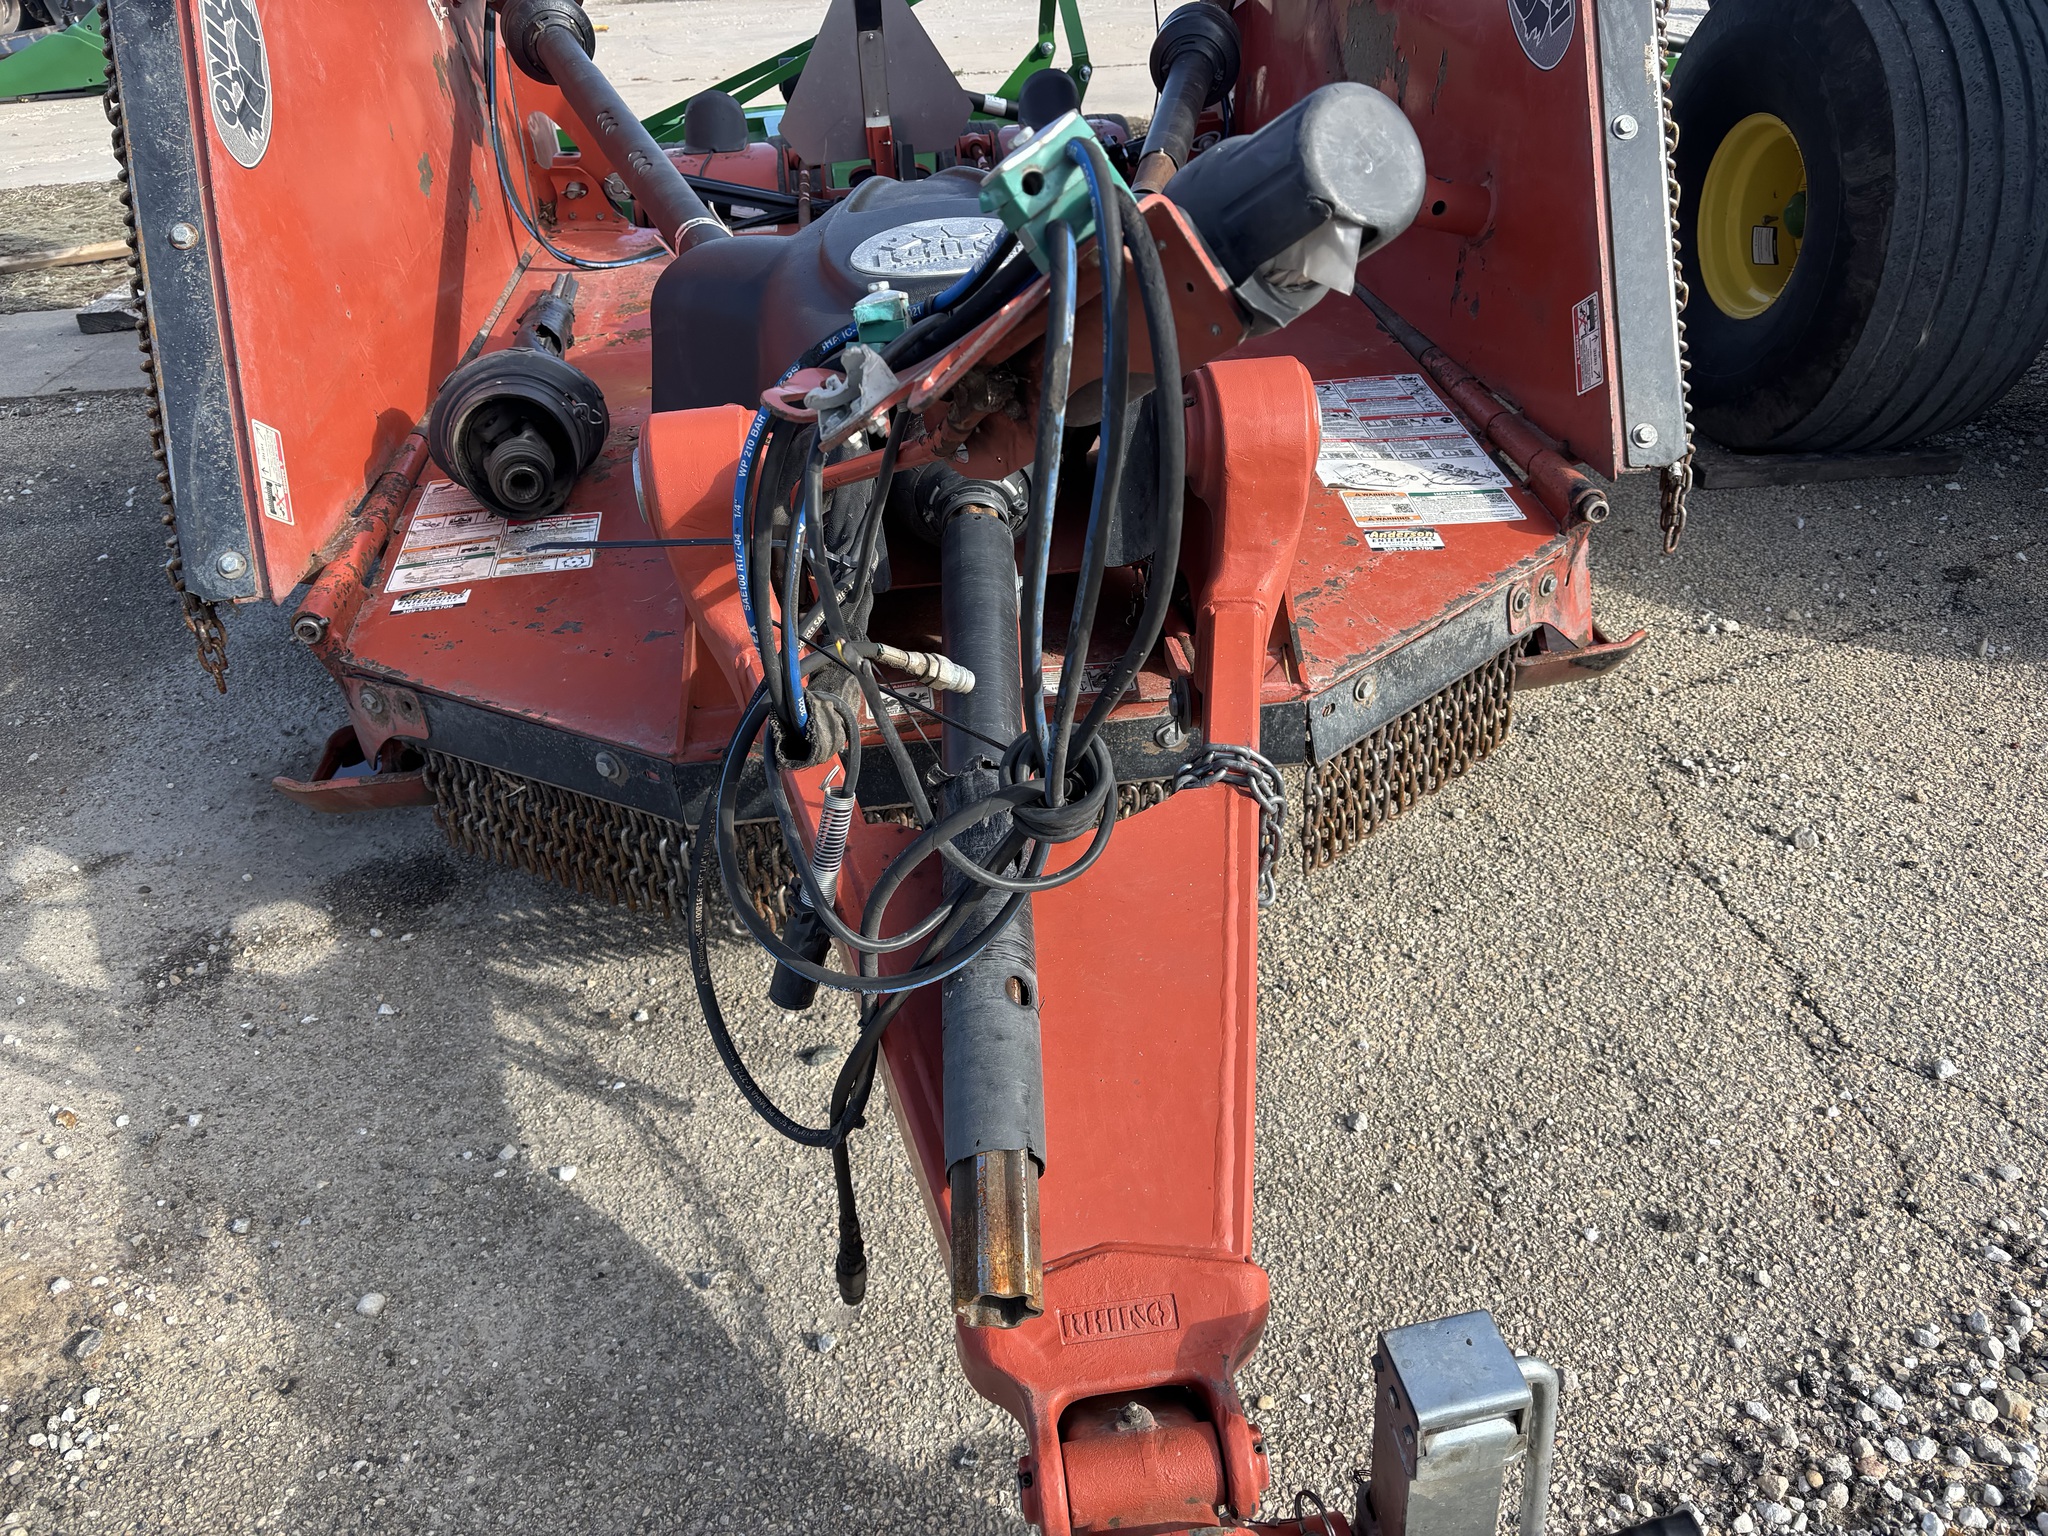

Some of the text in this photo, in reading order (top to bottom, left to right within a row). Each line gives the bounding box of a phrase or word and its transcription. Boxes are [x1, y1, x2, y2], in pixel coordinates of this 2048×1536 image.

[750, 414, 766, 438] BAR
[743, 440, 755, 458] 210
[738, 460, 749, 477] WP
[734, 499, 742, 518] 1/4"
[1369, 530, 1434, 539] Anderson
[426, 556, 466, 565] IMPORTANT
[735, 552, 744, 571] R17
[738, 574, 751, 611] SAE100
[694, 923, 703, 936] SAE
